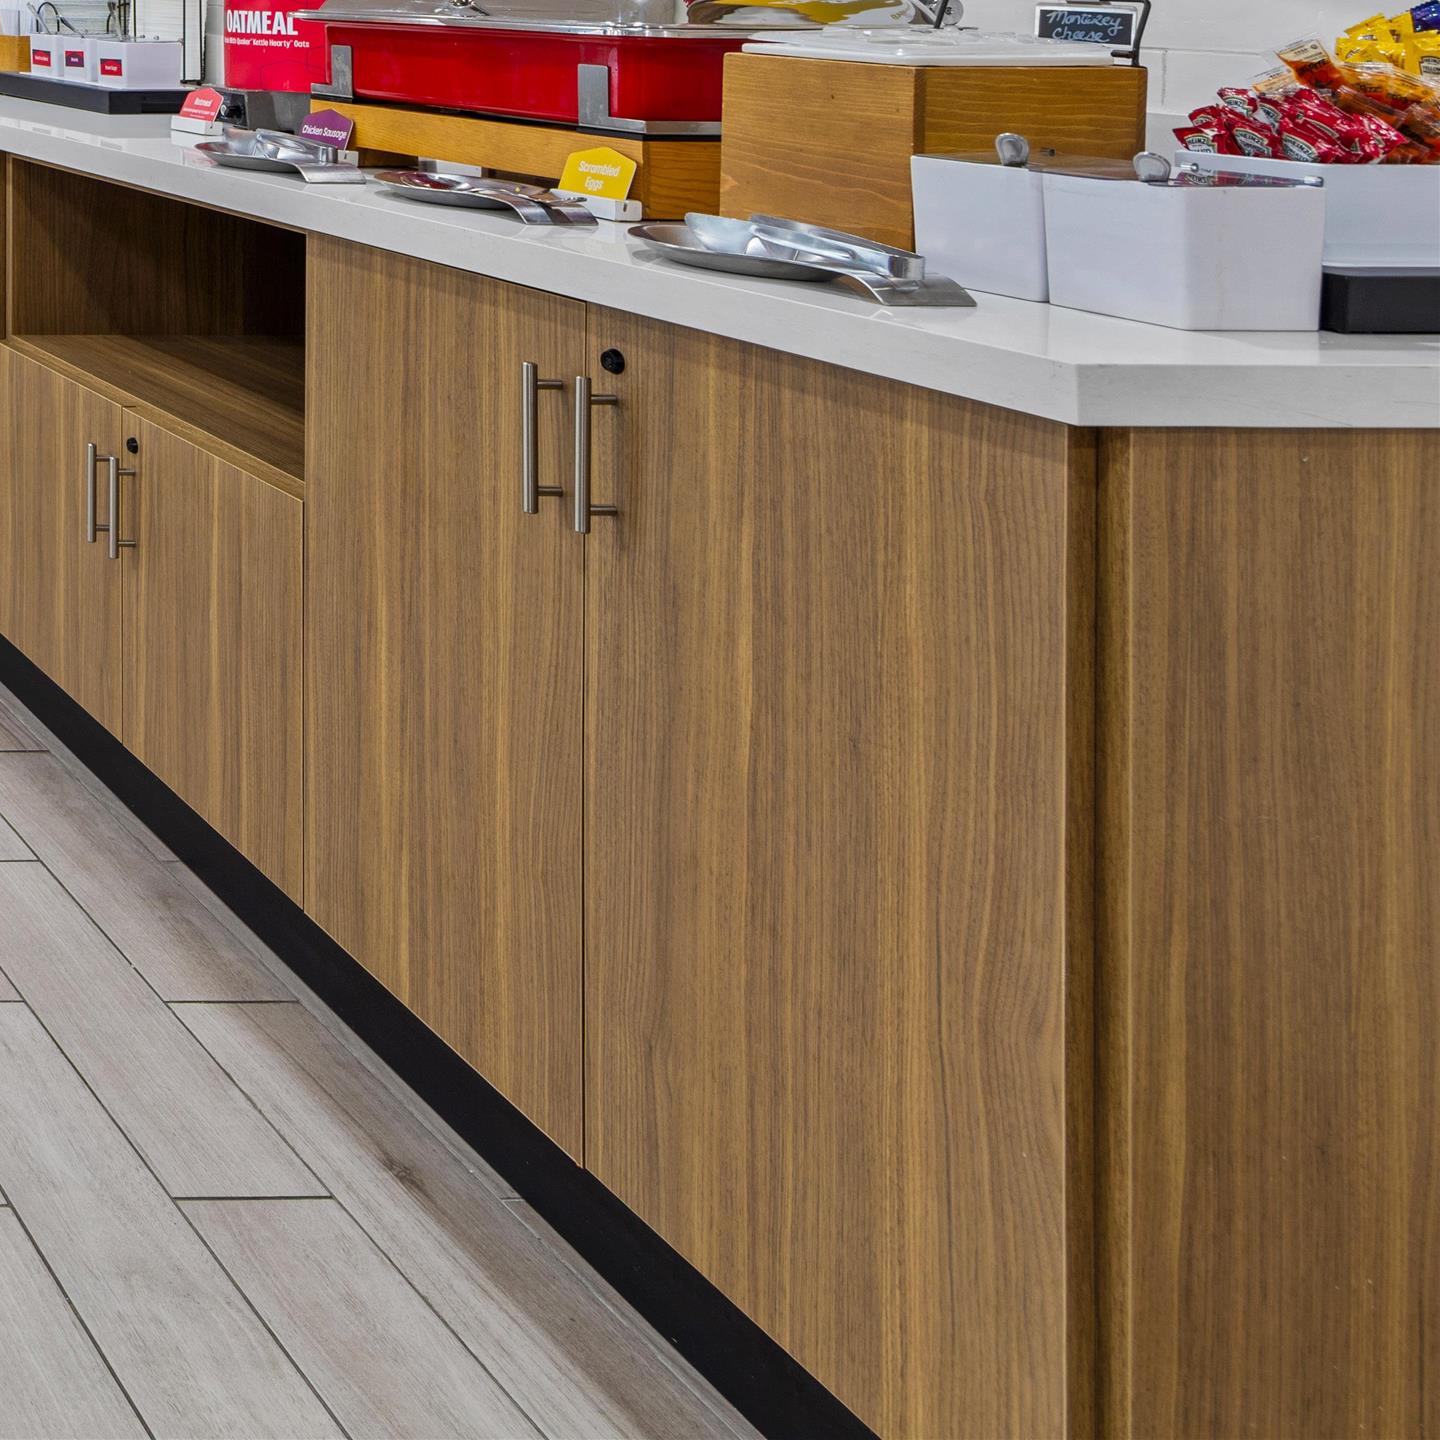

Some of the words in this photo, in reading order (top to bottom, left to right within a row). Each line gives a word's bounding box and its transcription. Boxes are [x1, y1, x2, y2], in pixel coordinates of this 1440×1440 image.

[226, 9, 299, 36] OATMEAL
[293, 40, 310, 48] Oats
[302, 124, 323, 137] Chicken
[323, 126, 347, 140] Sausage
[578, 160, 621, 177] Scrambled
[584, 176, 604, 192] Eggs
